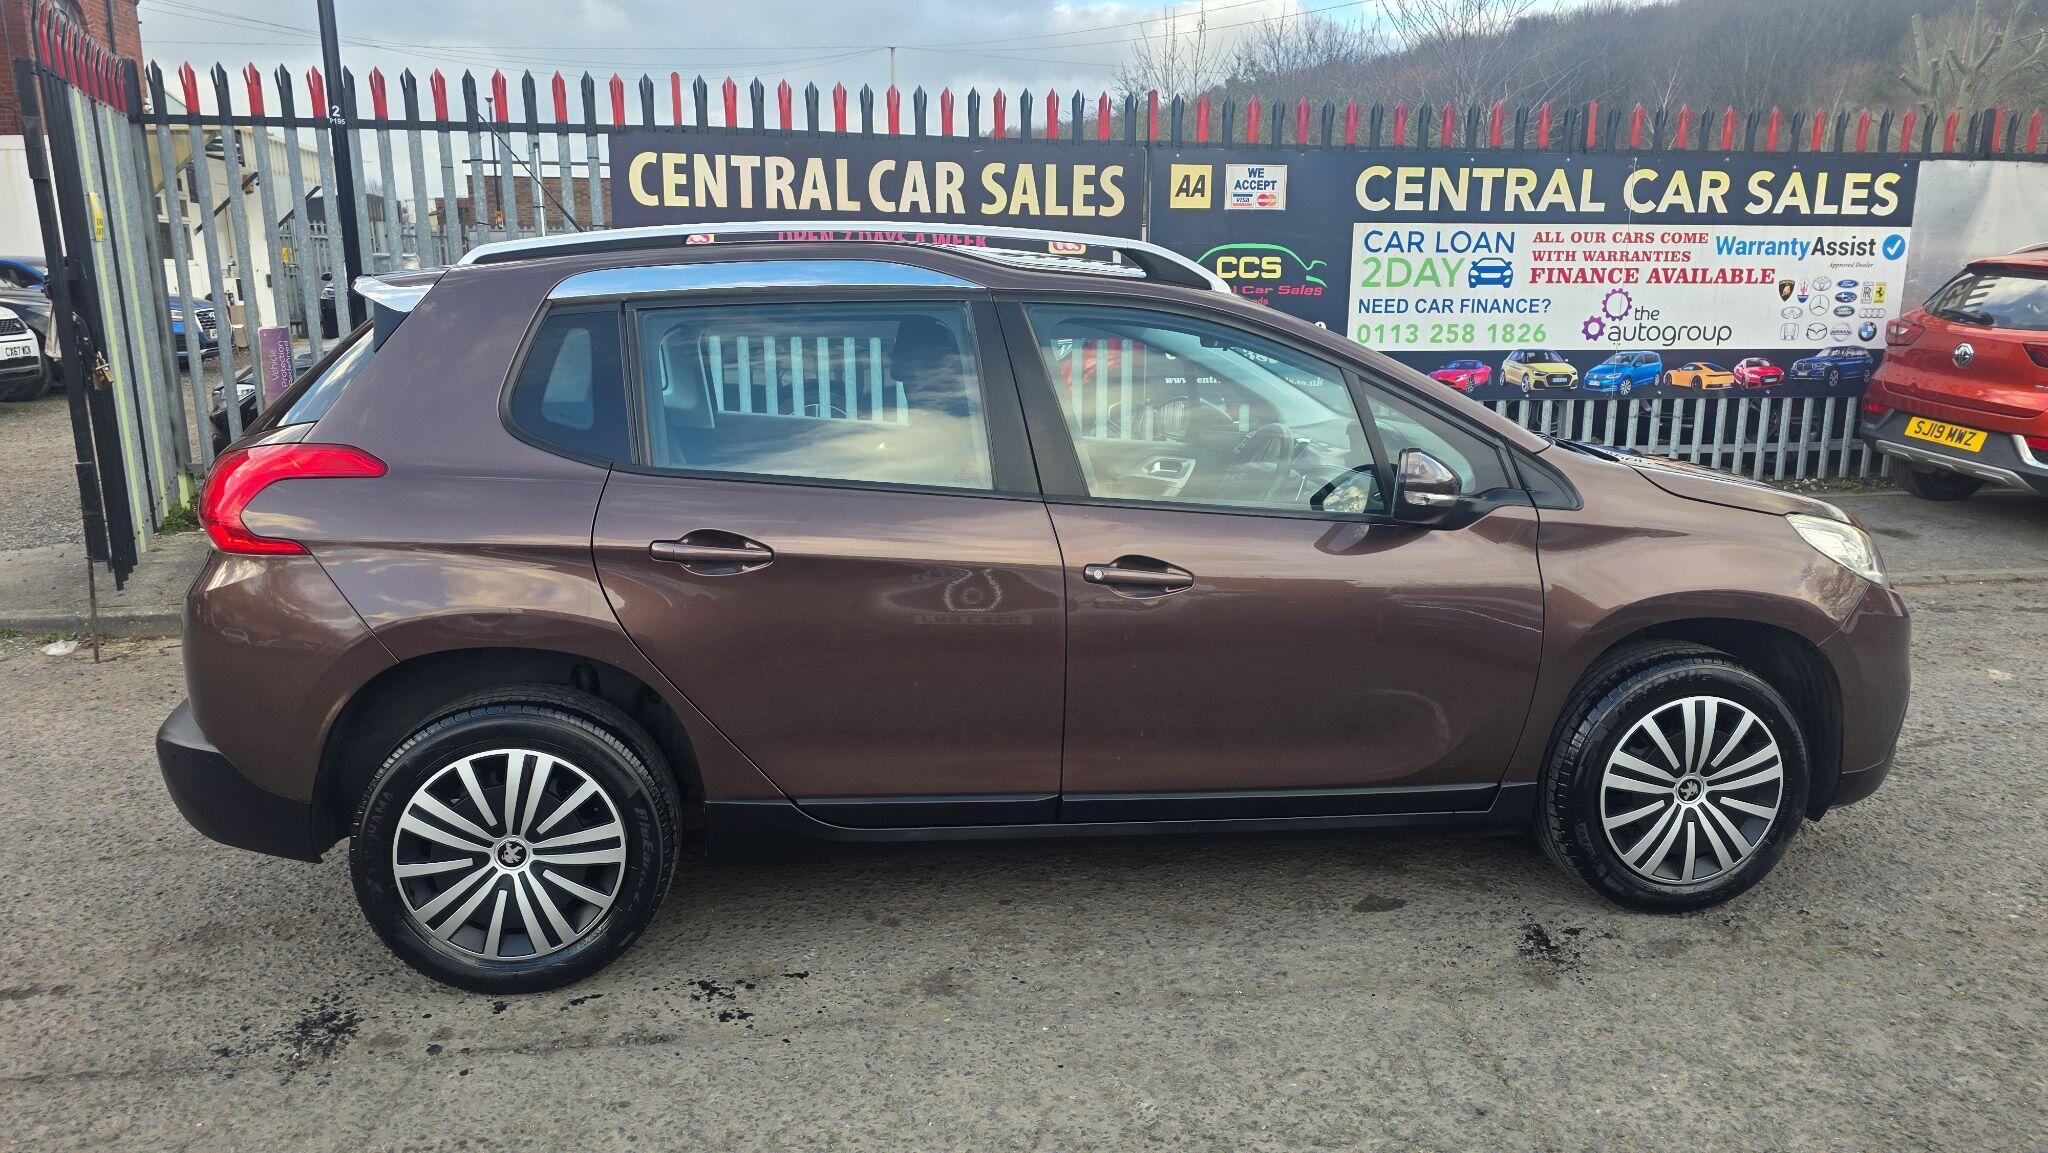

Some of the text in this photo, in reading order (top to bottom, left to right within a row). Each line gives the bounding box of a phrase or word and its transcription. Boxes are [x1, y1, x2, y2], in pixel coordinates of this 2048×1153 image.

[331, 105, 340, 117] 2
[1247, 167, 1265, 178] WE
[629, 152, 1126, 218] CENTRAL CAR SALES
[1174, 174, 1206, 198] AA
[1233, 179, 1278, 191] ACCEPT
[1355, 165, 1902, 217] CENTRAL CAR SALES
[1363, 230, 1515, 254] CAR LOAN
[1532, 231, 1709, 244] ALL OUR CARS COME
[1532, 250, 1691, 262] WITH WARRANTIES
[1216, 256, 1282, 279] CCS
[1361, 256, 1466, 288] 2DAY
[1528, 267, 1776, 285] FINANCE AVAILABLE
[1241, 285, 1274, 294] Car
[1277, 283, 1324, 296] Sales
[1358, 298, 1552, 314] NEED CAR FINANCE?
[1634, 305, 1660, 321] the
[1356, 323, 1547, 344] 0113 258 1826
[1607, 323, 1732, 347] autogroup
[269, 348, 280, 381] Vehicle
[277, 340, 289, 388] Protection
[1913, 420, 1977, 447] SJ19 MWZ
